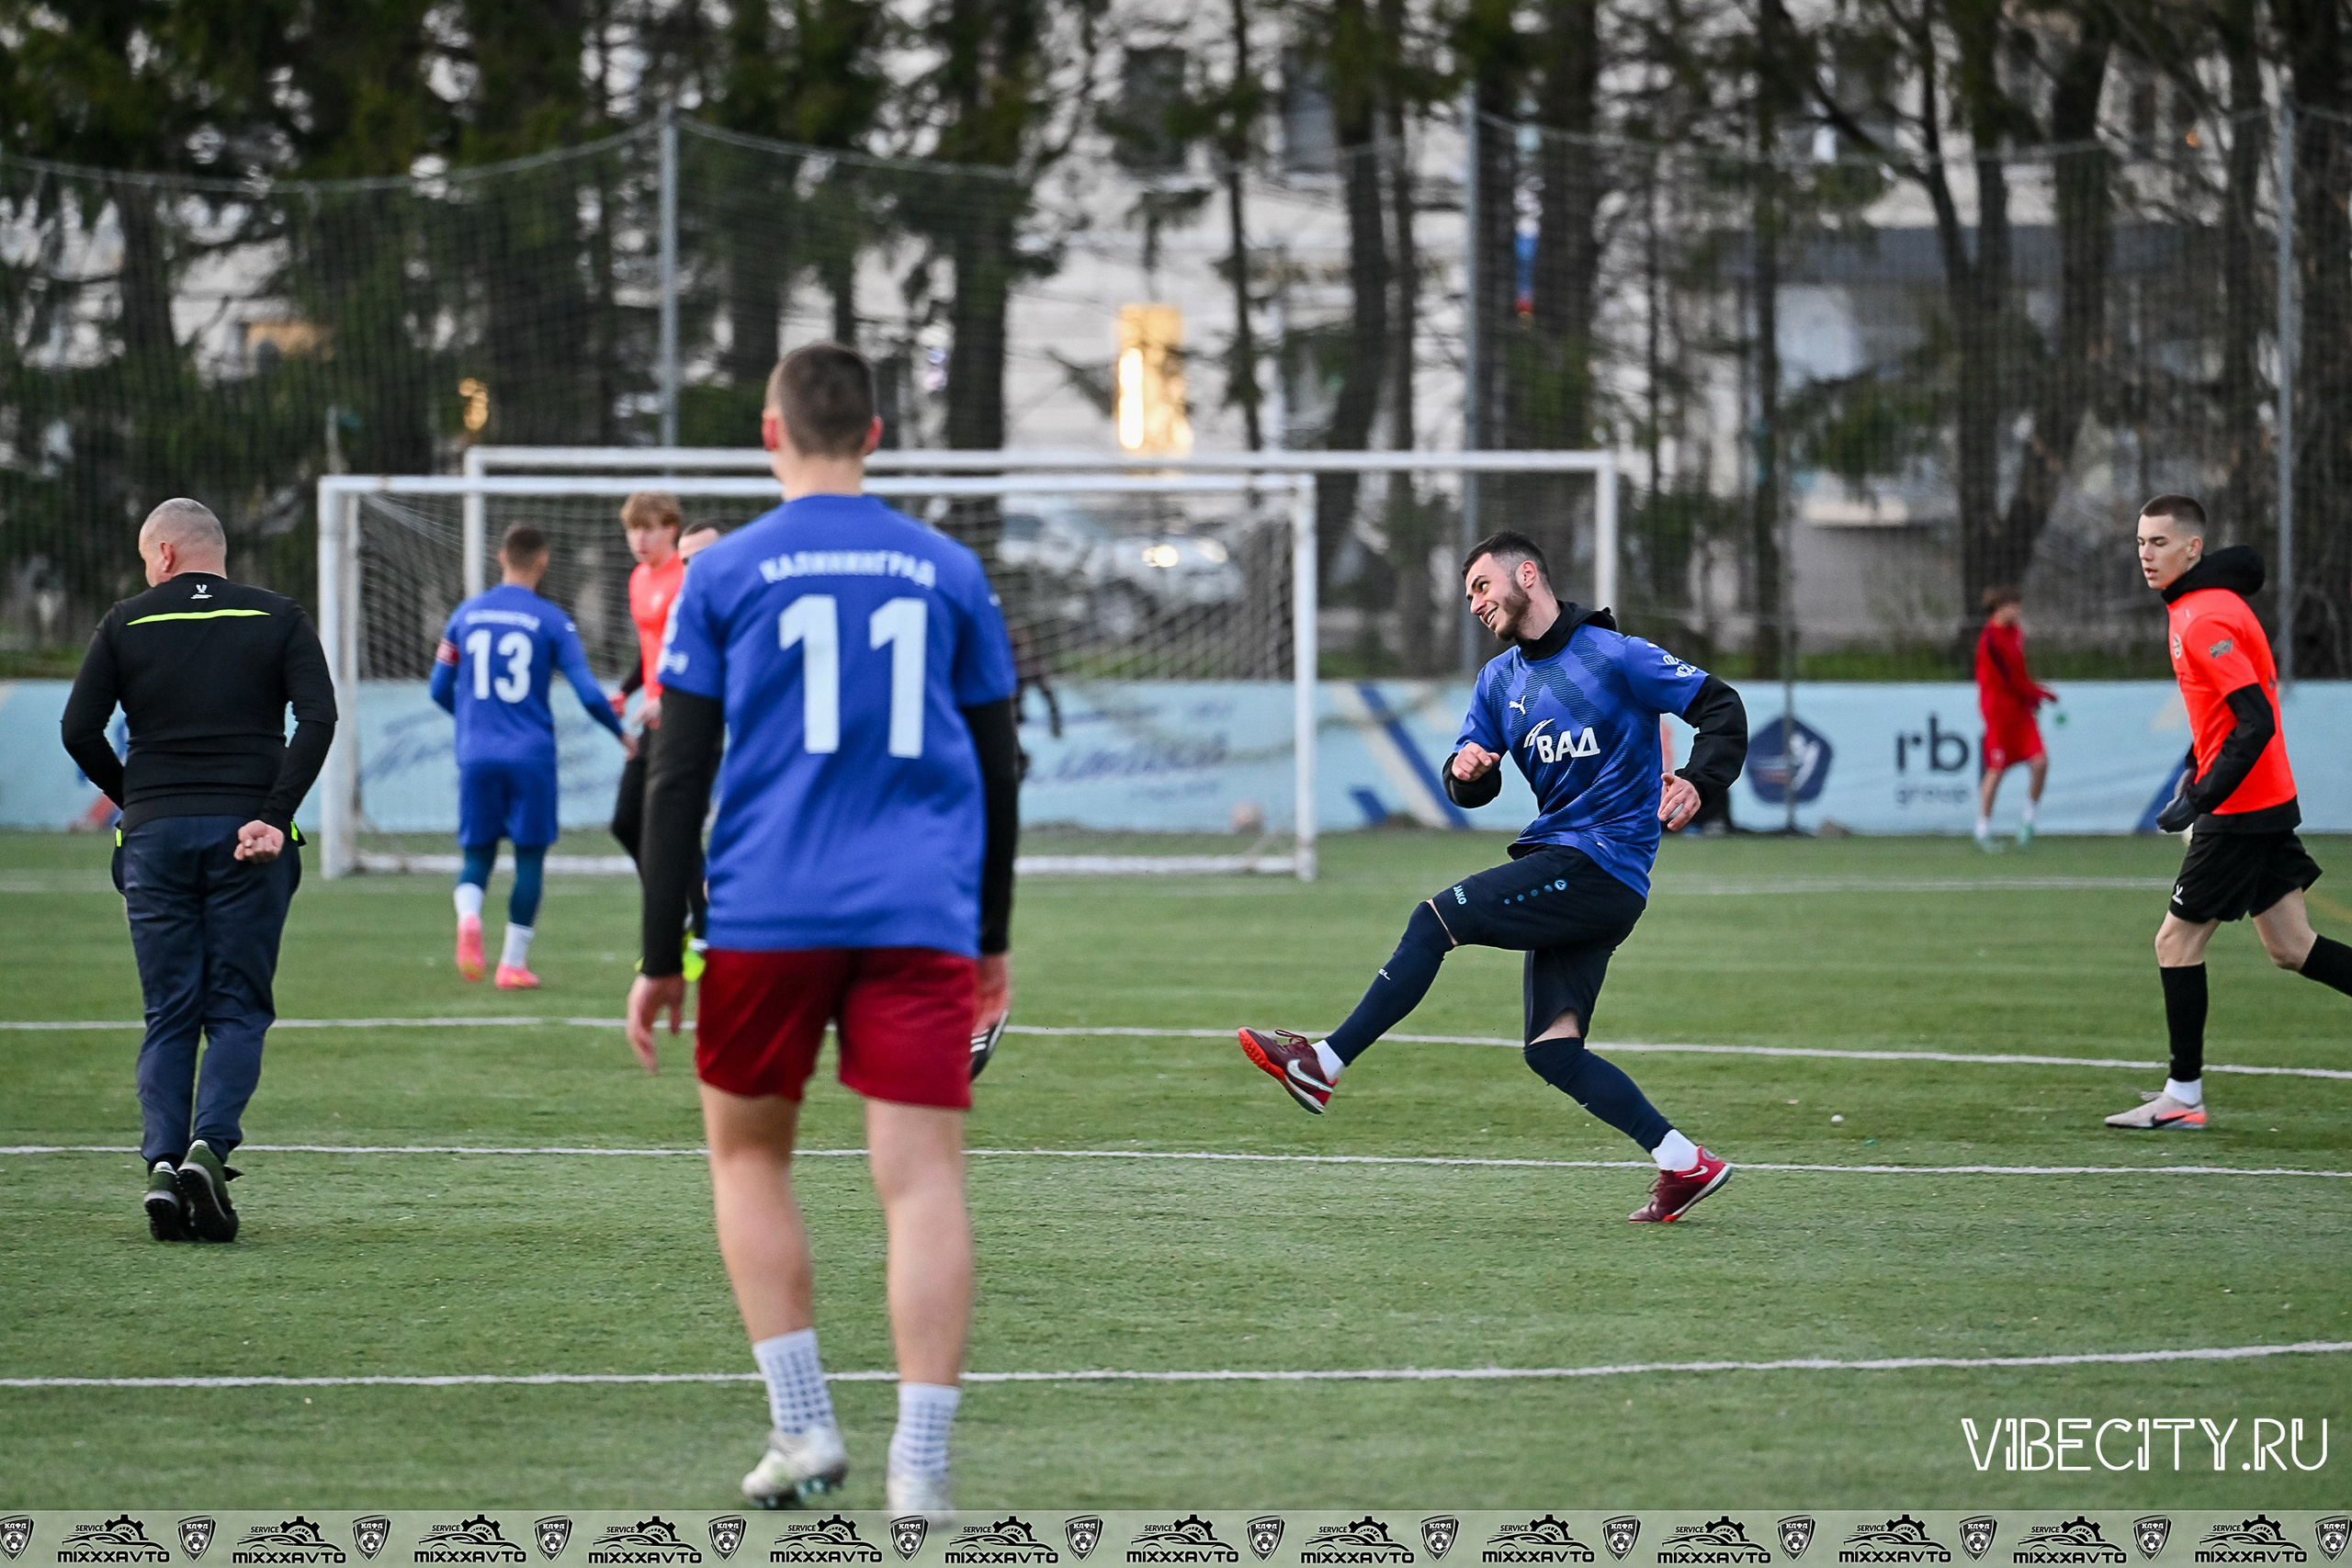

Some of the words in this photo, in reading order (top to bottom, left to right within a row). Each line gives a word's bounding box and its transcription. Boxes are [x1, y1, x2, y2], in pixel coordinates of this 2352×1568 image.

[465, 629, 533, 704] 13
[778, 593, 927, 759] 11
[1895, 712, 1970, 772] rb
